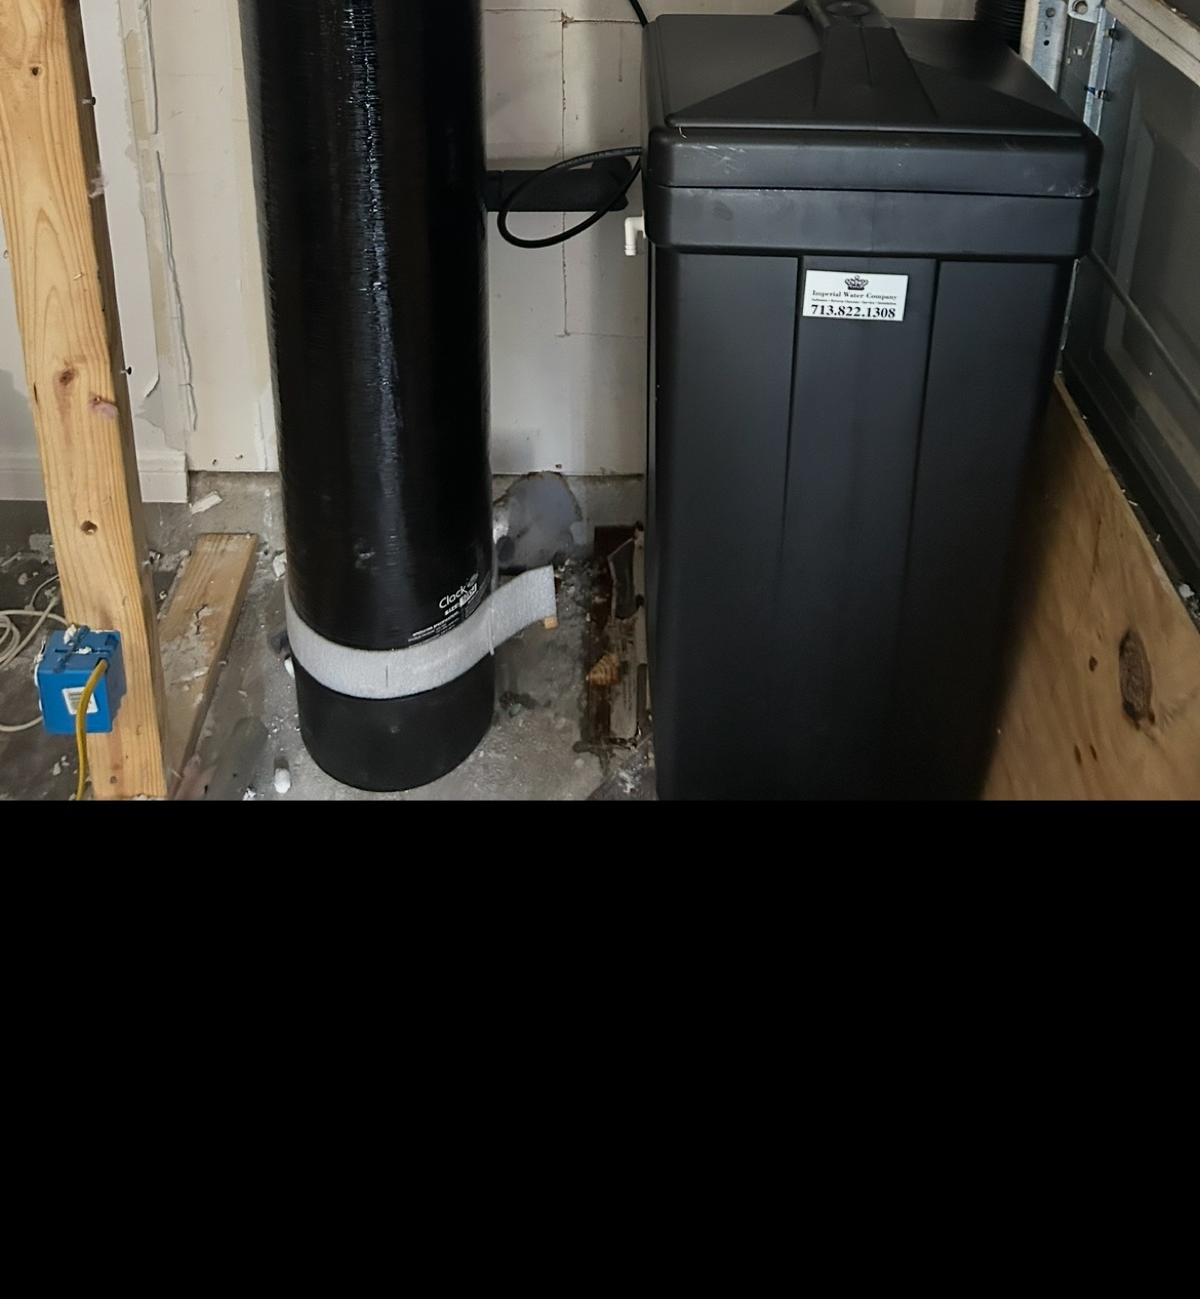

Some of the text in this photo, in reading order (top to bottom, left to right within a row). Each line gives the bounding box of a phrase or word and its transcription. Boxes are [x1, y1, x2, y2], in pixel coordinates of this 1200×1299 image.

[812, 290, 897, 301] Imperial Water Company
[810, 304, 896, 319] 713.822.1308
